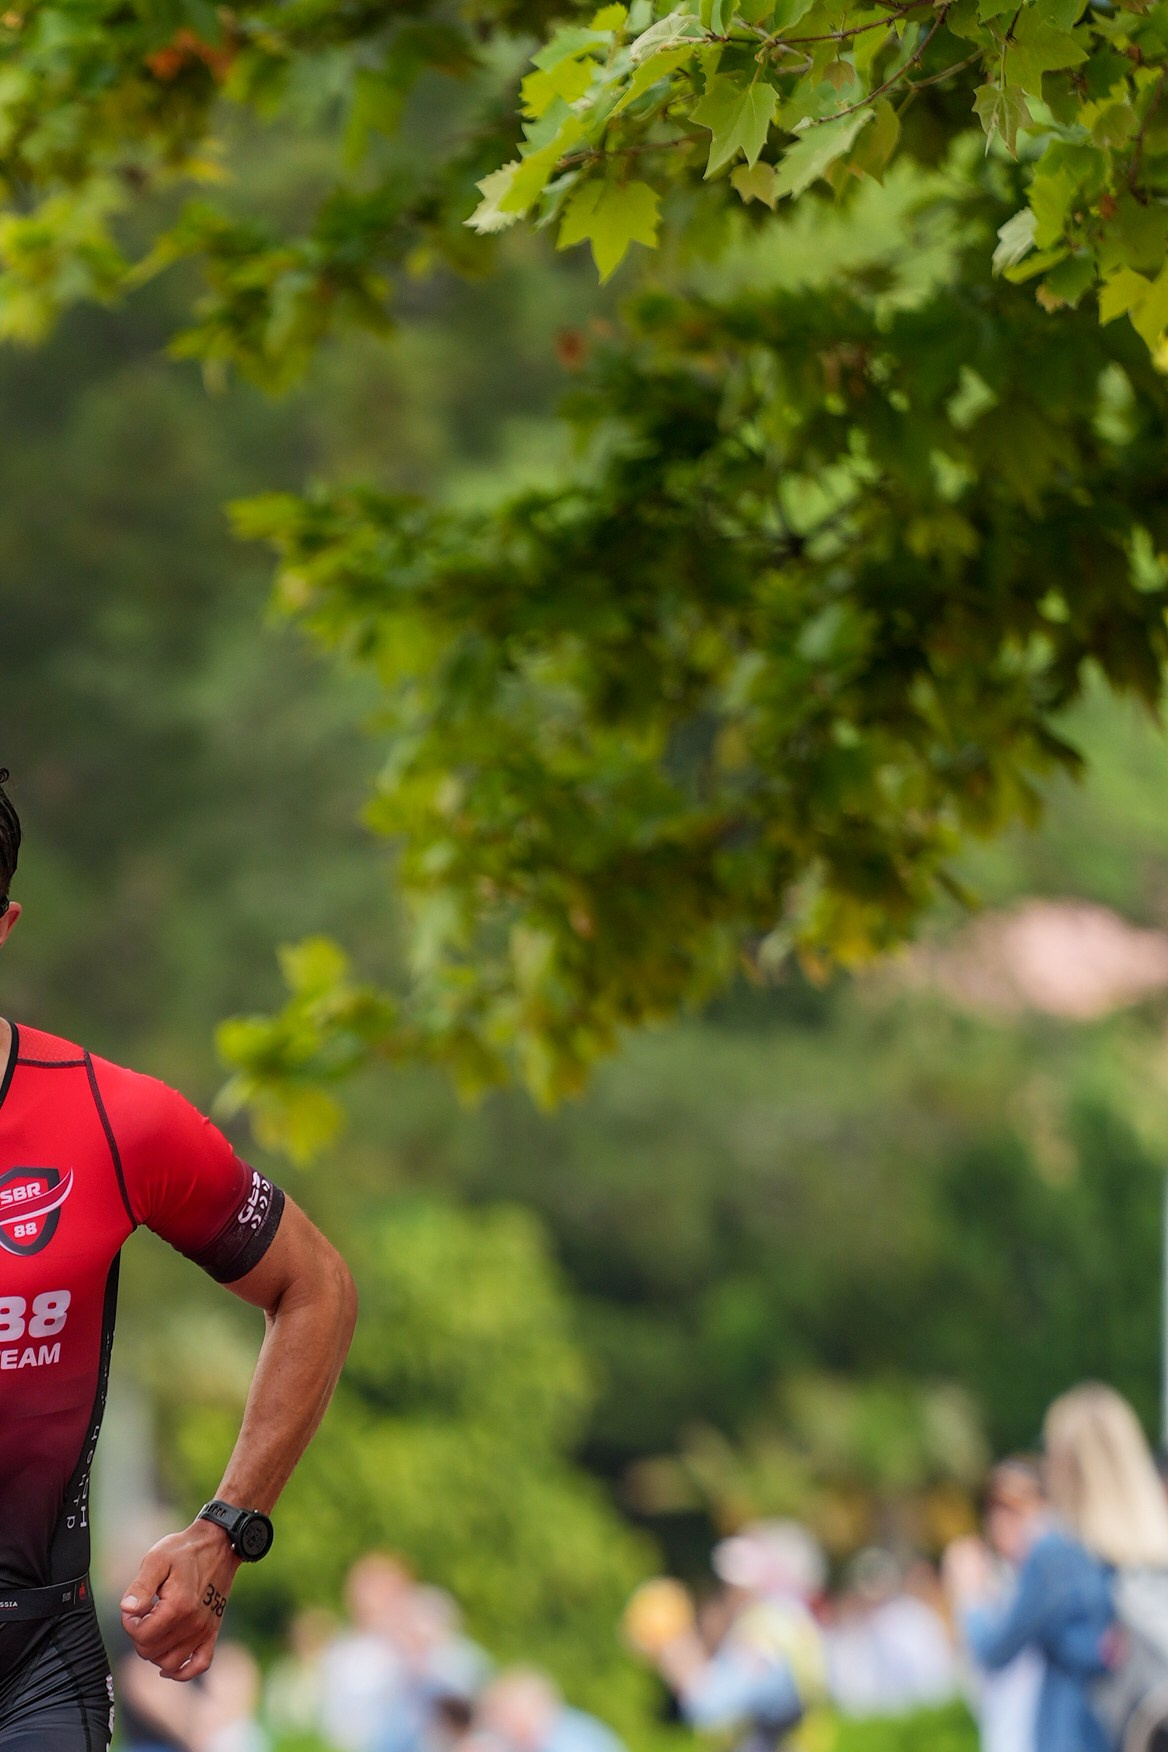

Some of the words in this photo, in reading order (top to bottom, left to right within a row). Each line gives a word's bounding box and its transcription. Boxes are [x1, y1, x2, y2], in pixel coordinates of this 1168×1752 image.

[0, 1181, 41, 1205] SBR
[13, 1222, 38, 1239] 88
[203, 1584, 227, 1618] 358
